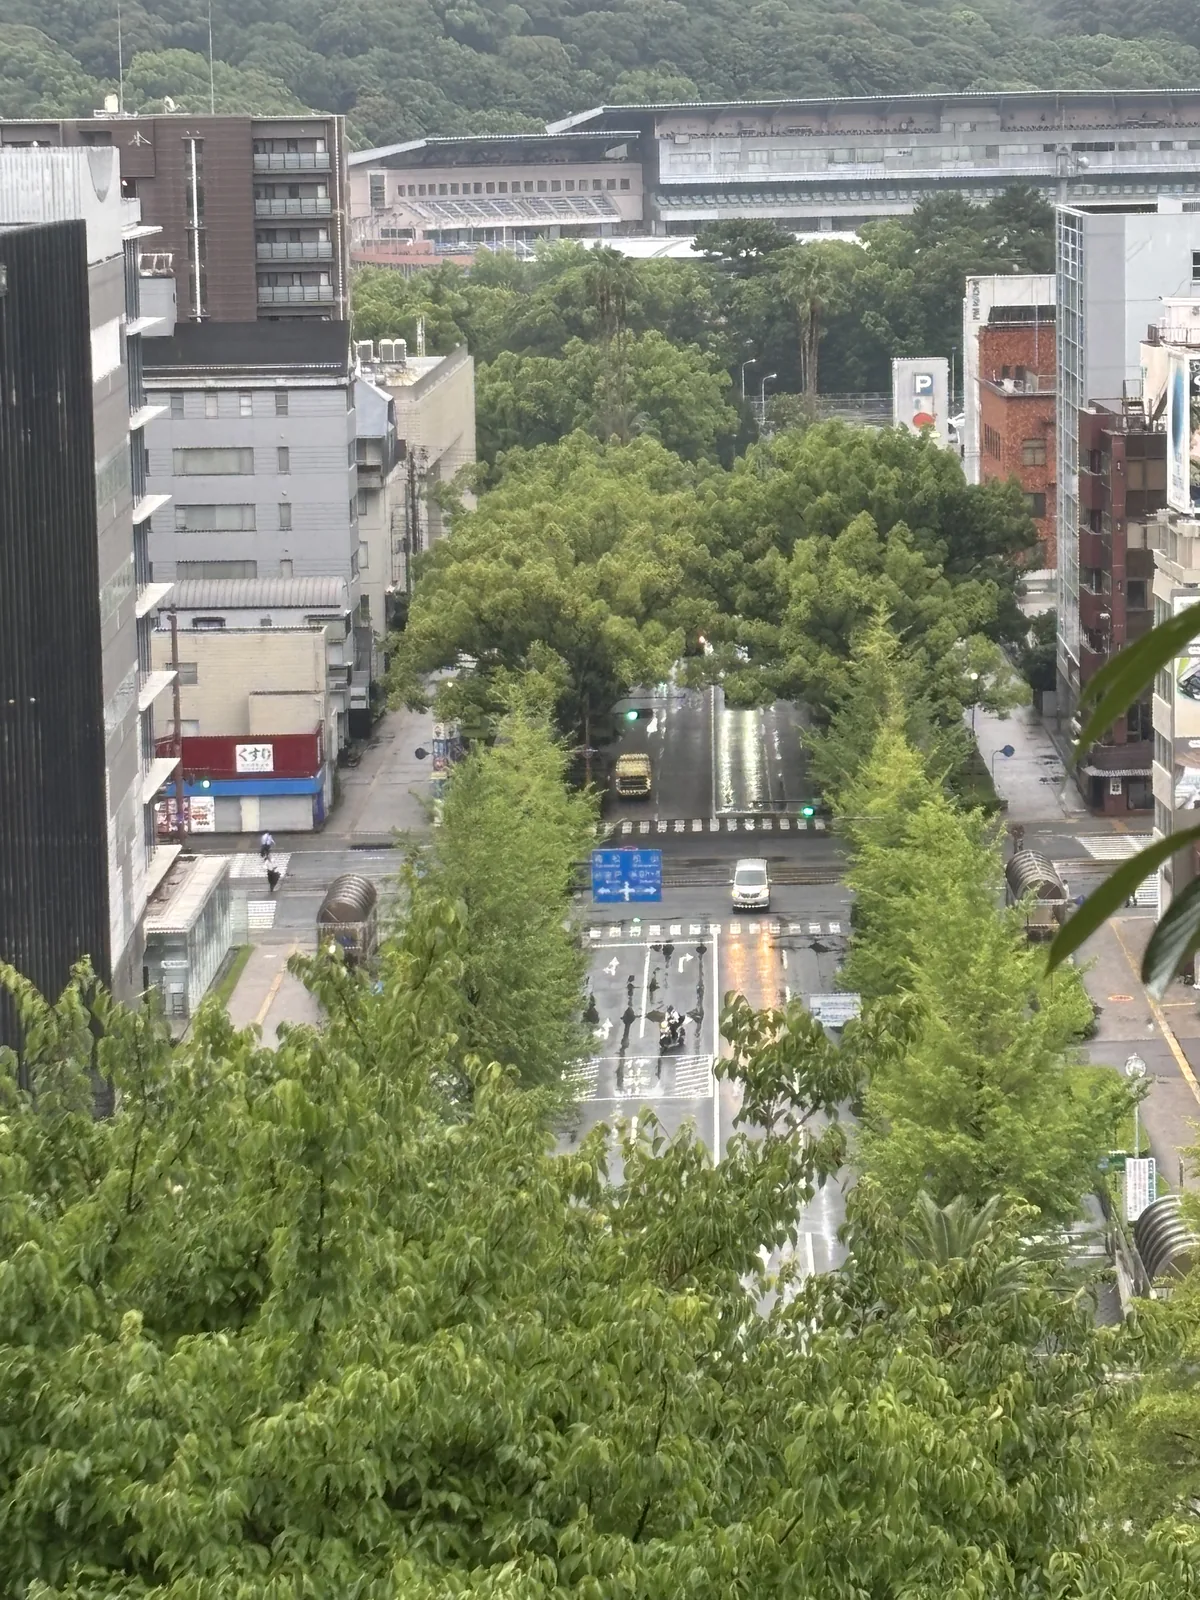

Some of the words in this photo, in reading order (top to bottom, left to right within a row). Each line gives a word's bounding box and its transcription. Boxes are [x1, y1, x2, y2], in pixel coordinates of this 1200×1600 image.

[915, 374, 932, 394] P
[238, 747, 271, 762] くすり
